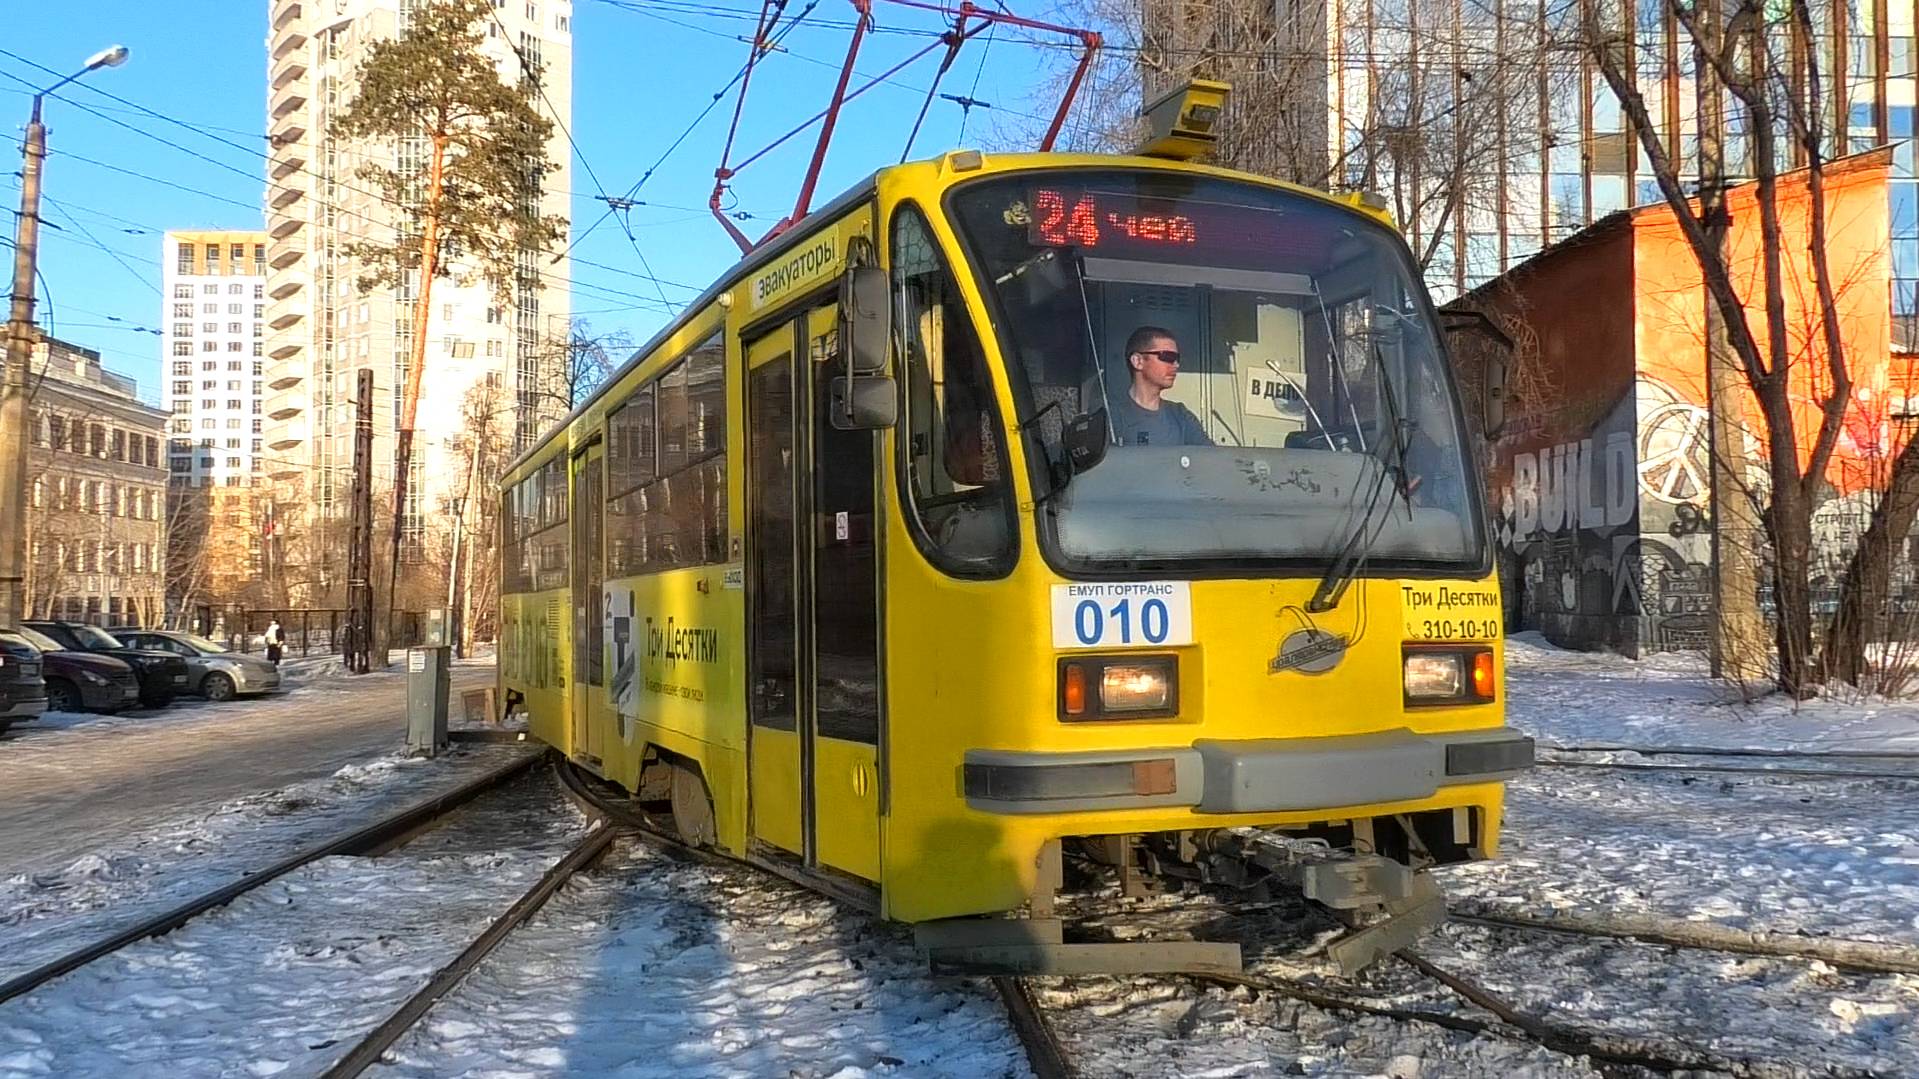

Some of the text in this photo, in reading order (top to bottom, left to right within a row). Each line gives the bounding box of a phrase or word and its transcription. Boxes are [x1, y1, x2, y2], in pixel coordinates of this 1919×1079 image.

[1036, 190, 1100, 247] 24
[758, 237, 836, 299] эвакуаторы
[1251, 378, 1261, 396] В
[1514, 431, 1636, 536] BUILD
[1068, 584, 1173, 596] ЕМУП ГОРТРАНС
[1402, 586, 1498, 610] Три Десятки
[646, 616, 717, 670] Три Десятки
[1074, 598, 1169, 645] 010
[1423, 620, 1498, 639] 310-10-10
